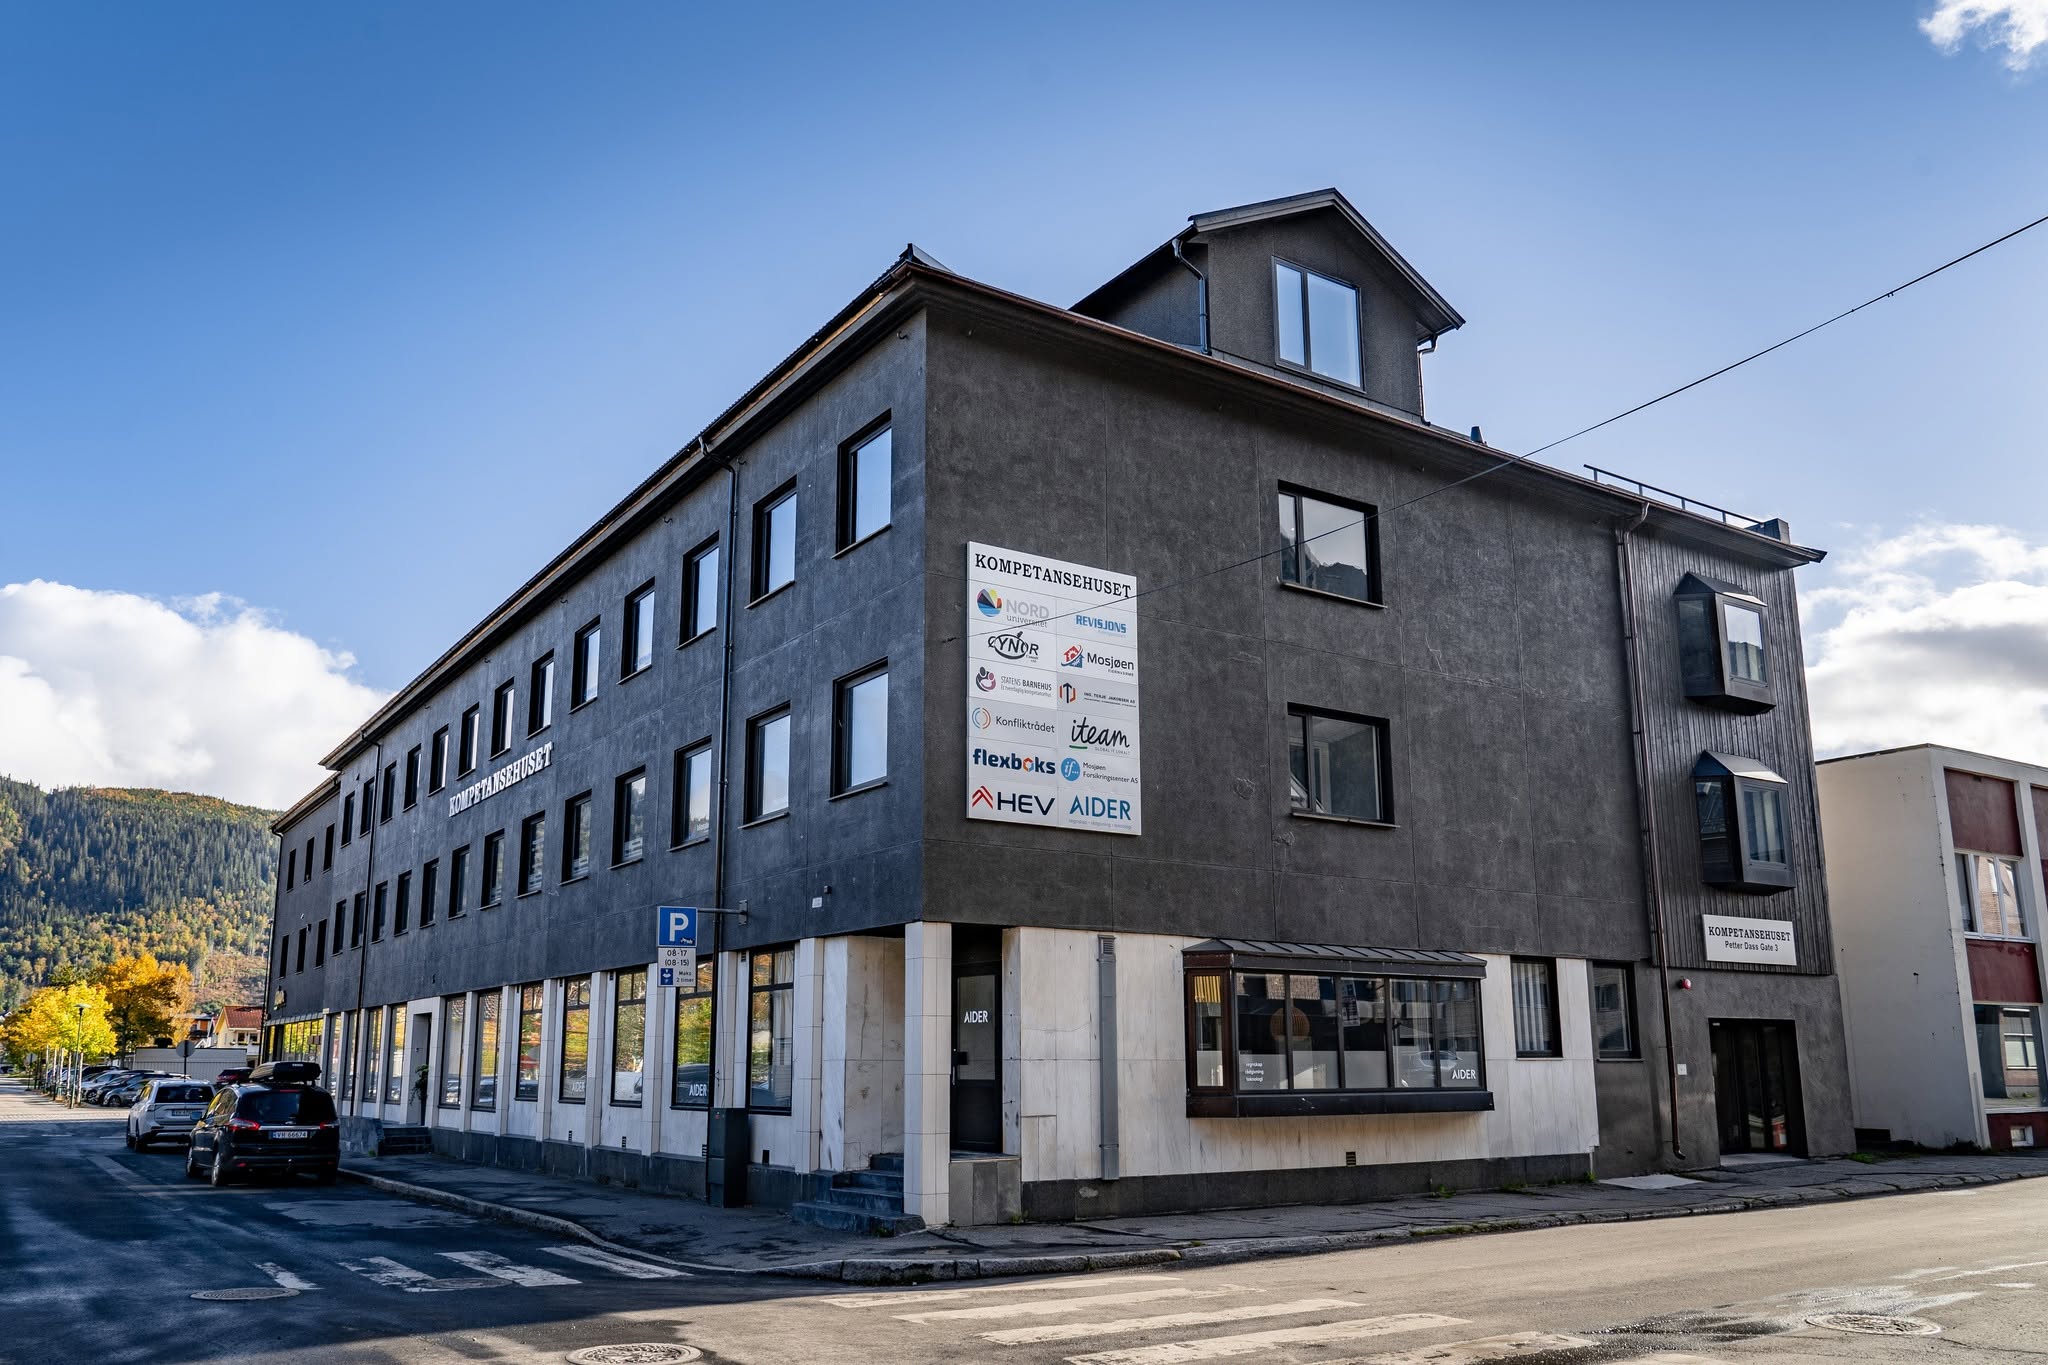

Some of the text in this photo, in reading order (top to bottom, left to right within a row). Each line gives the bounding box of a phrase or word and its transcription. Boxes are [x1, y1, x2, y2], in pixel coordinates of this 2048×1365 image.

[975, 553, 1132, 598] KOMPETANSEHUSET
[1006, 599, 1049, 619] NORD
[1007, 614, 1048, 628] universitet
[1076, 614, 1126, 633] REVISJONS
[1087, 652, 1134, 670] Mosjøen
[1001, 676, 1021, 687] STATENS
[1022, 679, 1052, 691] BARNEHUS
[996, 715, 1055, 733] Konfliktrådet
[1071, 716, 1130, 748] iteam
[973, 748, 1056, 775] flexboks
[449, 741, 553, 817] KOMPETANSEHUSET
[998, 786, 1055, 816] HEV
[1069, 795, 1131, 820] AIDER
[669, 912, 689, 942] P
[1708, 926, 1791, 941] KOMPETANSEHUSET
[1725, 940, 1743, 949] Petter
[1744, 942, 1759, 951] Dass
[1760, 943, 1774, 951] Gate
[665, 958, 689, 966] (08-15)
[963, 1010, 988, 1023] AIDER
[1452, 1069, 1476, 1080] AIDER
[571, 1081, 586, 1093] AIDER
[688, 1084, 707, 1097] AIDER
